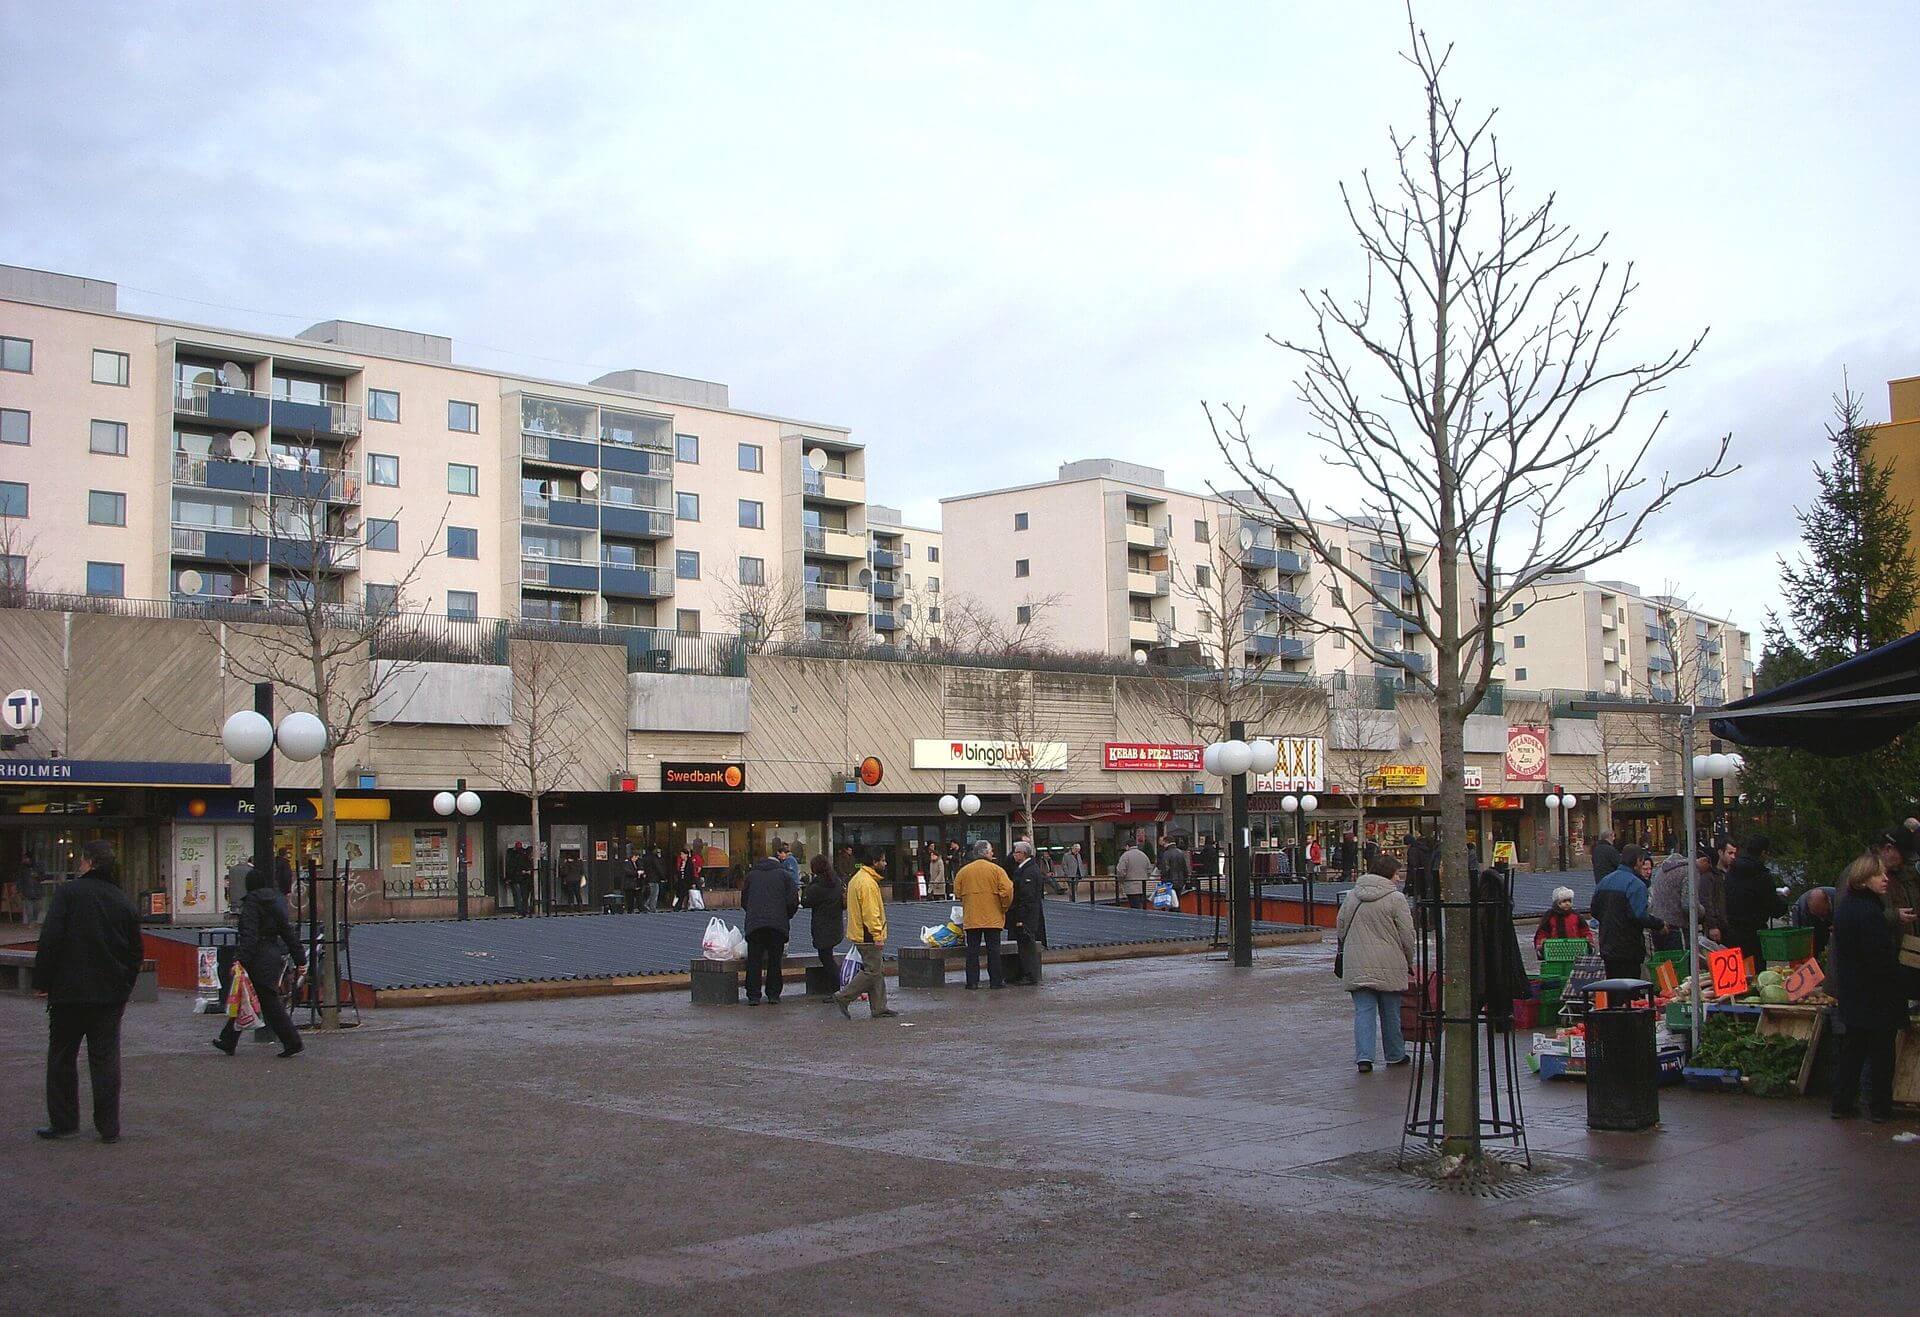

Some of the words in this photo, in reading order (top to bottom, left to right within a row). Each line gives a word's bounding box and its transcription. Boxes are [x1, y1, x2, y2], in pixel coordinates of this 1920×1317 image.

[8, 697, 27, 724] T
[1108, 748, 1138, 761] KEBAB
[1139, 749, 1146, 759] &
[1147, 749, 1171, 760] PIZZA
[1172, 749, 1200, 762] HUSET
[1263, 740, 1316, 777] AXI
[667, 769, 724, 782] Swedbank
[238, 800, 298, 815] Preyrån
[1715, 954, 1738, 990] 29
